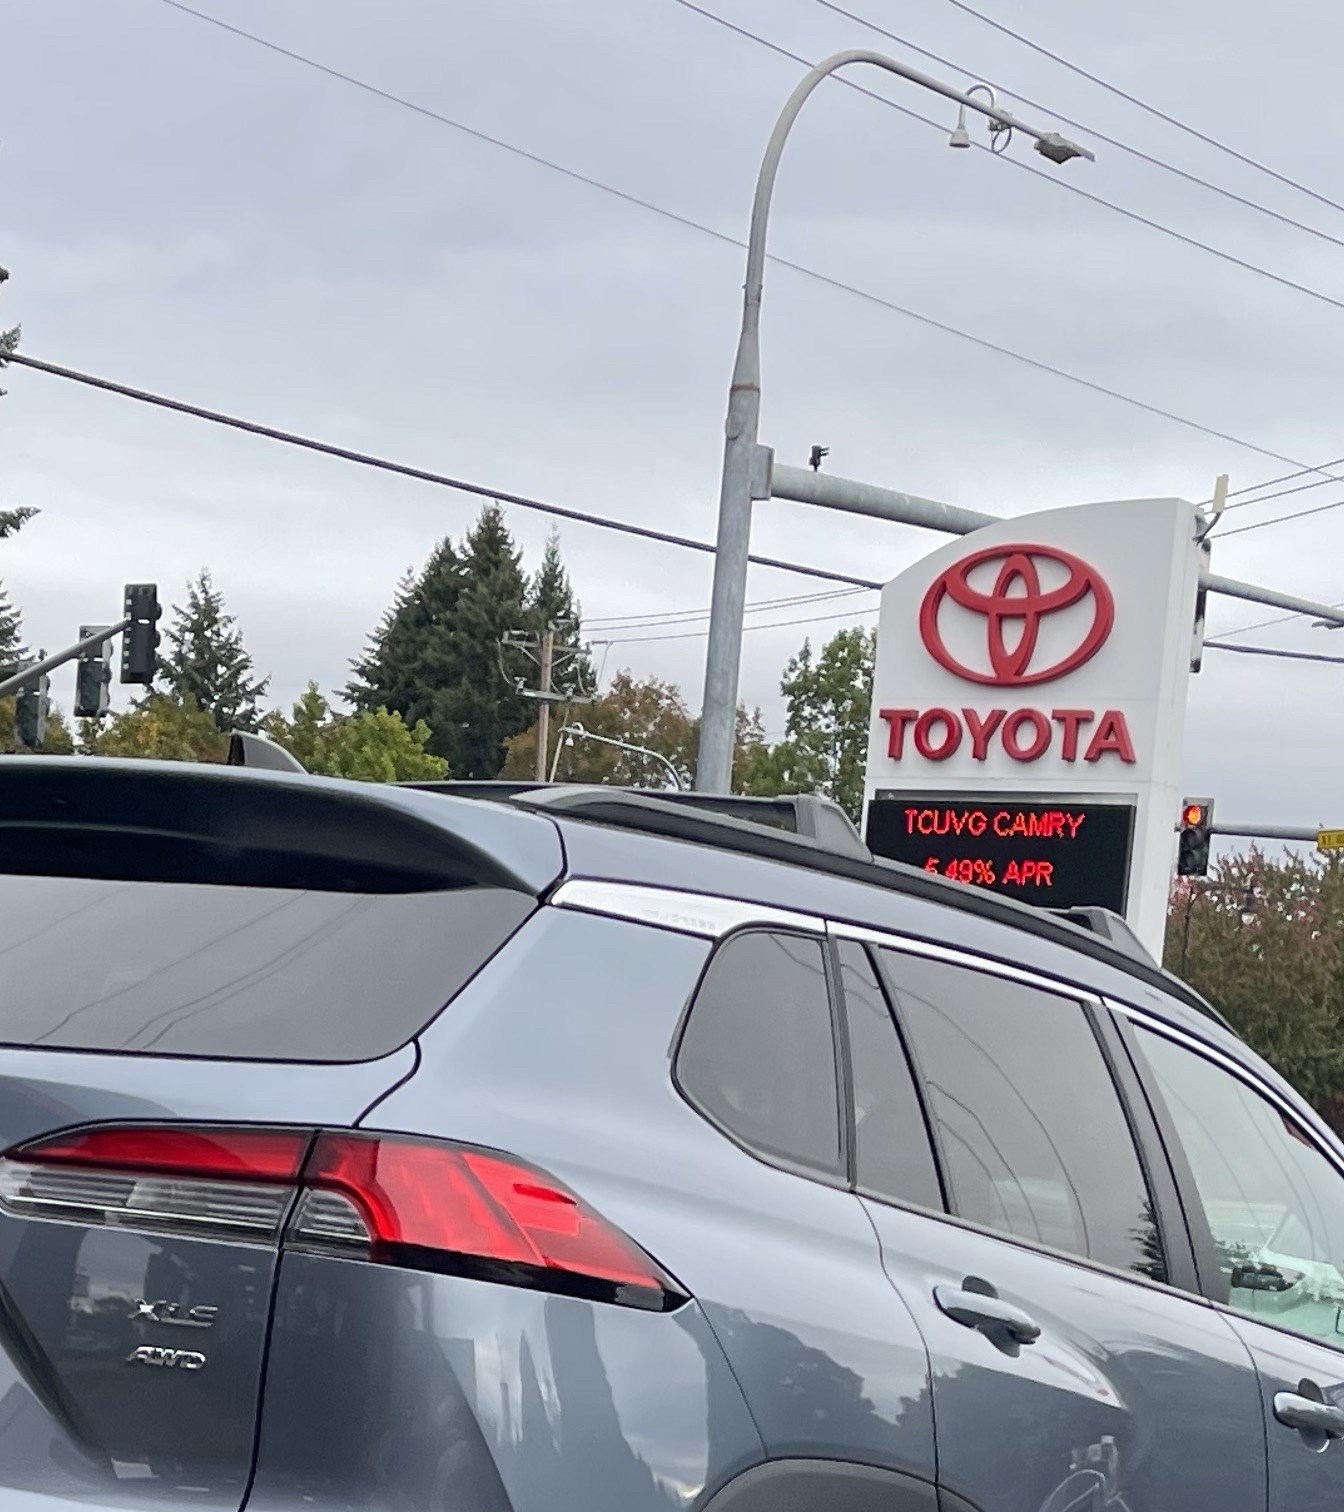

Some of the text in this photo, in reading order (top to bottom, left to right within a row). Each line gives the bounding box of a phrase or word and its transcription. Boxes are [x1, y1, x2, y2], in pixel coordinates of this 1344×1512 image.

[879, 707, 1136, 765] TOYOTA
[993, 811, 1086, 839] CAMRY
[1002, 859, 1054, 887] APR
[128, 1346, 205, 1369] AWD
